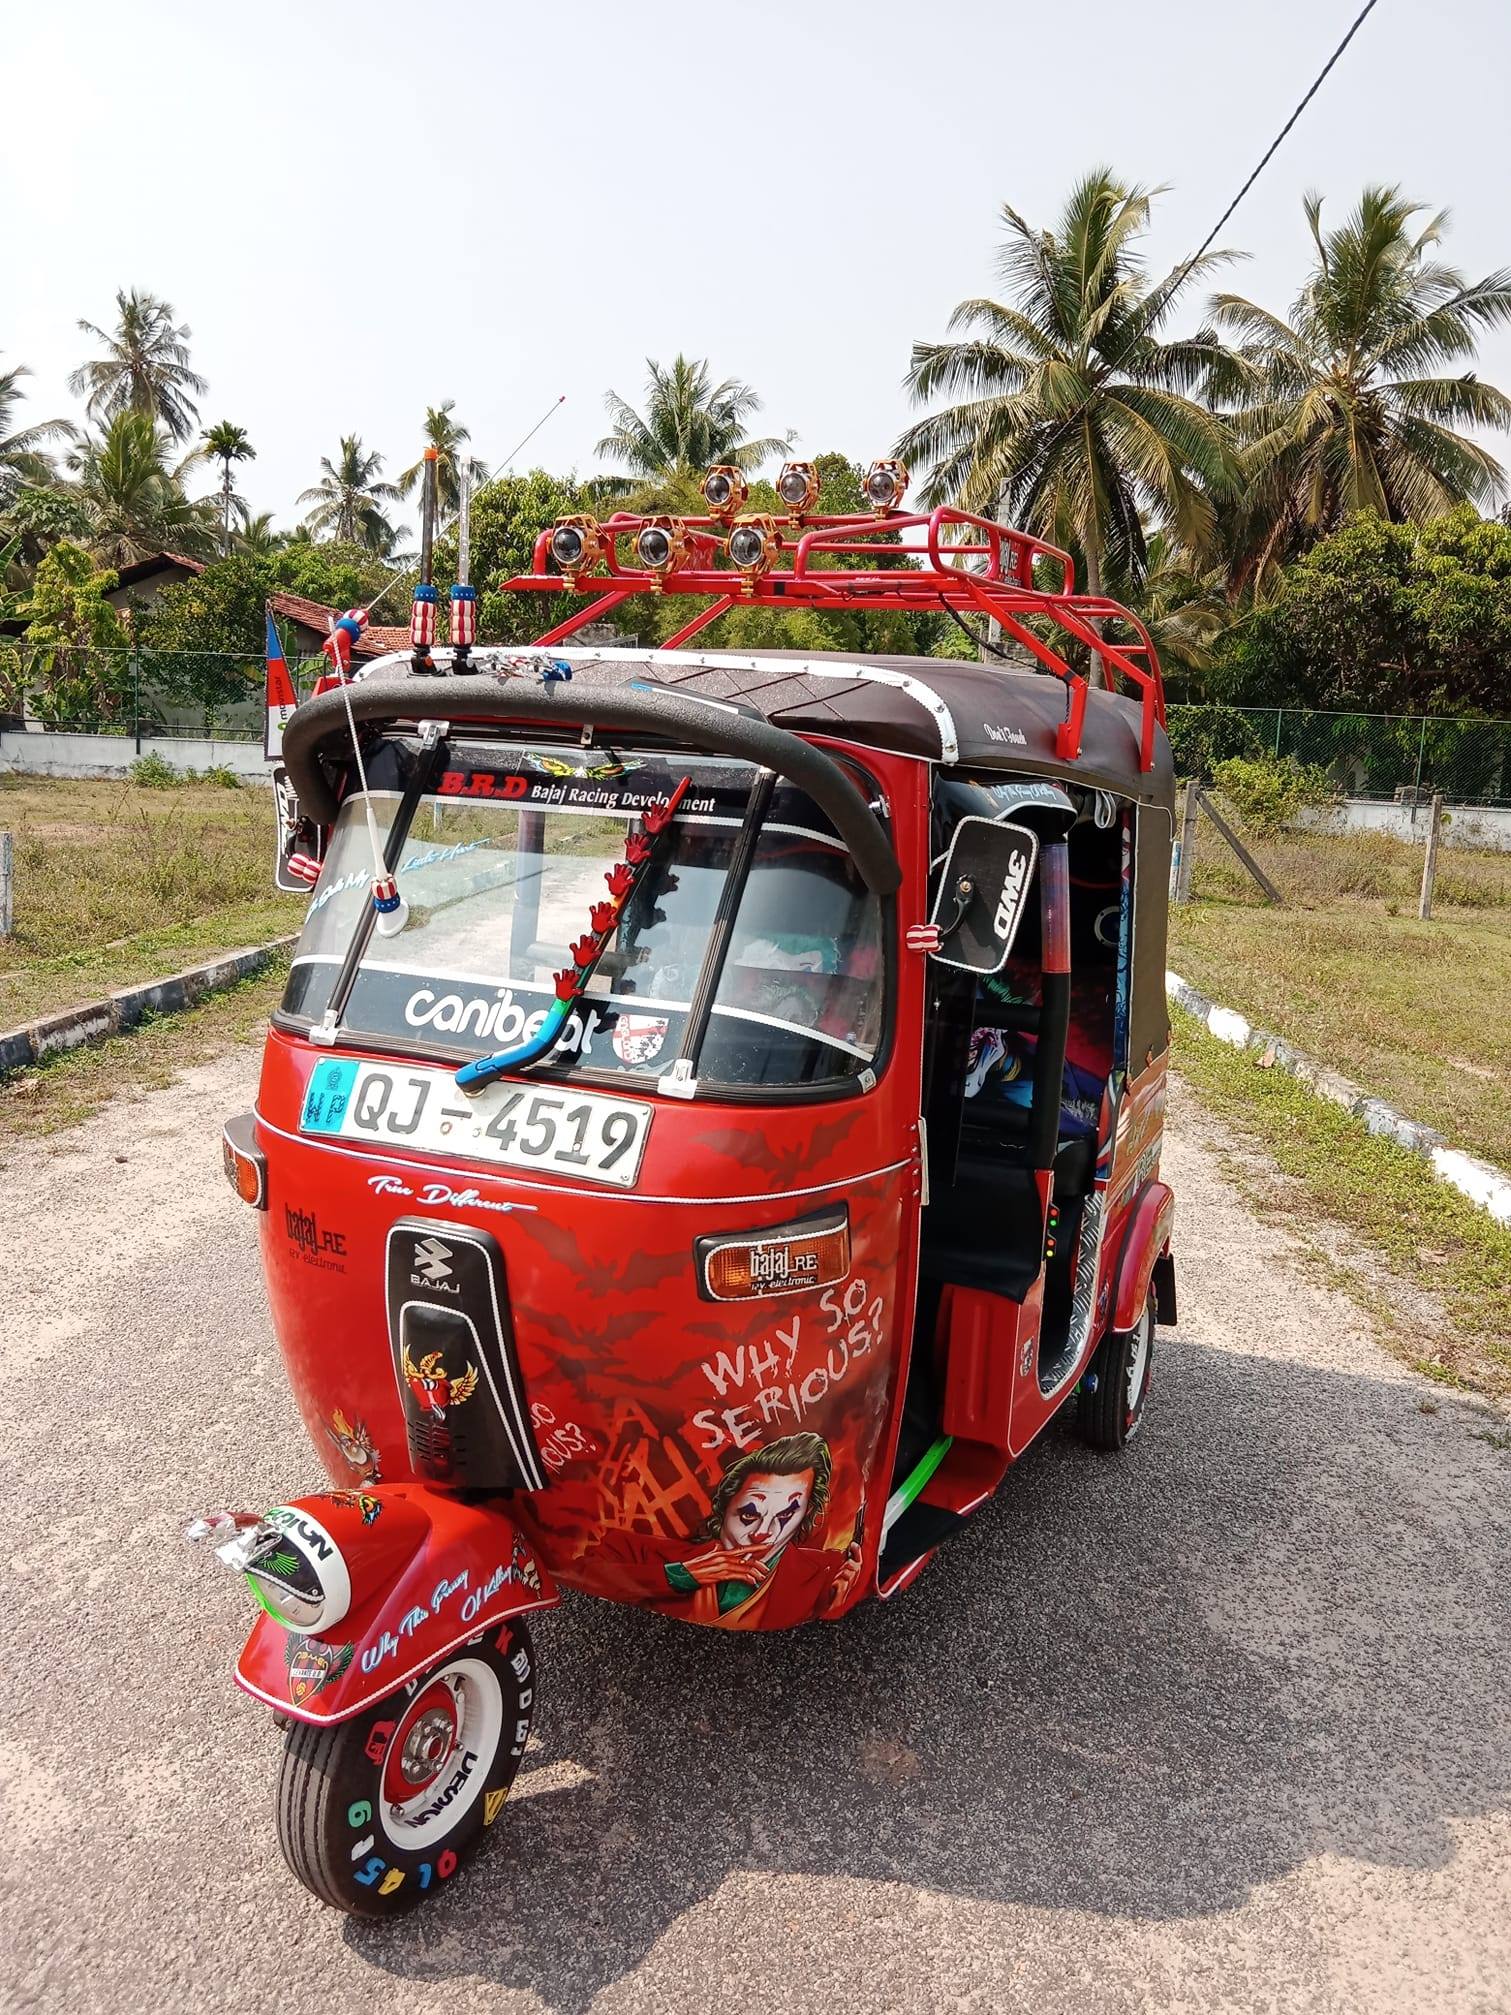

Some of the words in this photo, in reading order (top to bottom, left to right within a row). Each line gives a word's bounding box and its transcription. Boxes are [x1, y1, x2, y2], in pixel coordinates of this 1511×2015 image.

[530, 784, 569, 805] Bajaj
[568, 788, 618, 809] Racing
[621, 791, 717, 813] Develoment
[993, 849, 1027, 940] 3WD
[416, 1184, 539, 1212] Different
[410, 1273, 461, 1295] BAJAJ
[692, 1296, 884, 1449] SERIOUS?
[701, 1315, 801, 1397] WHY
[819, 1278, 867, 1333] SO
[403, 1750, 479, 1830] DESIGN
